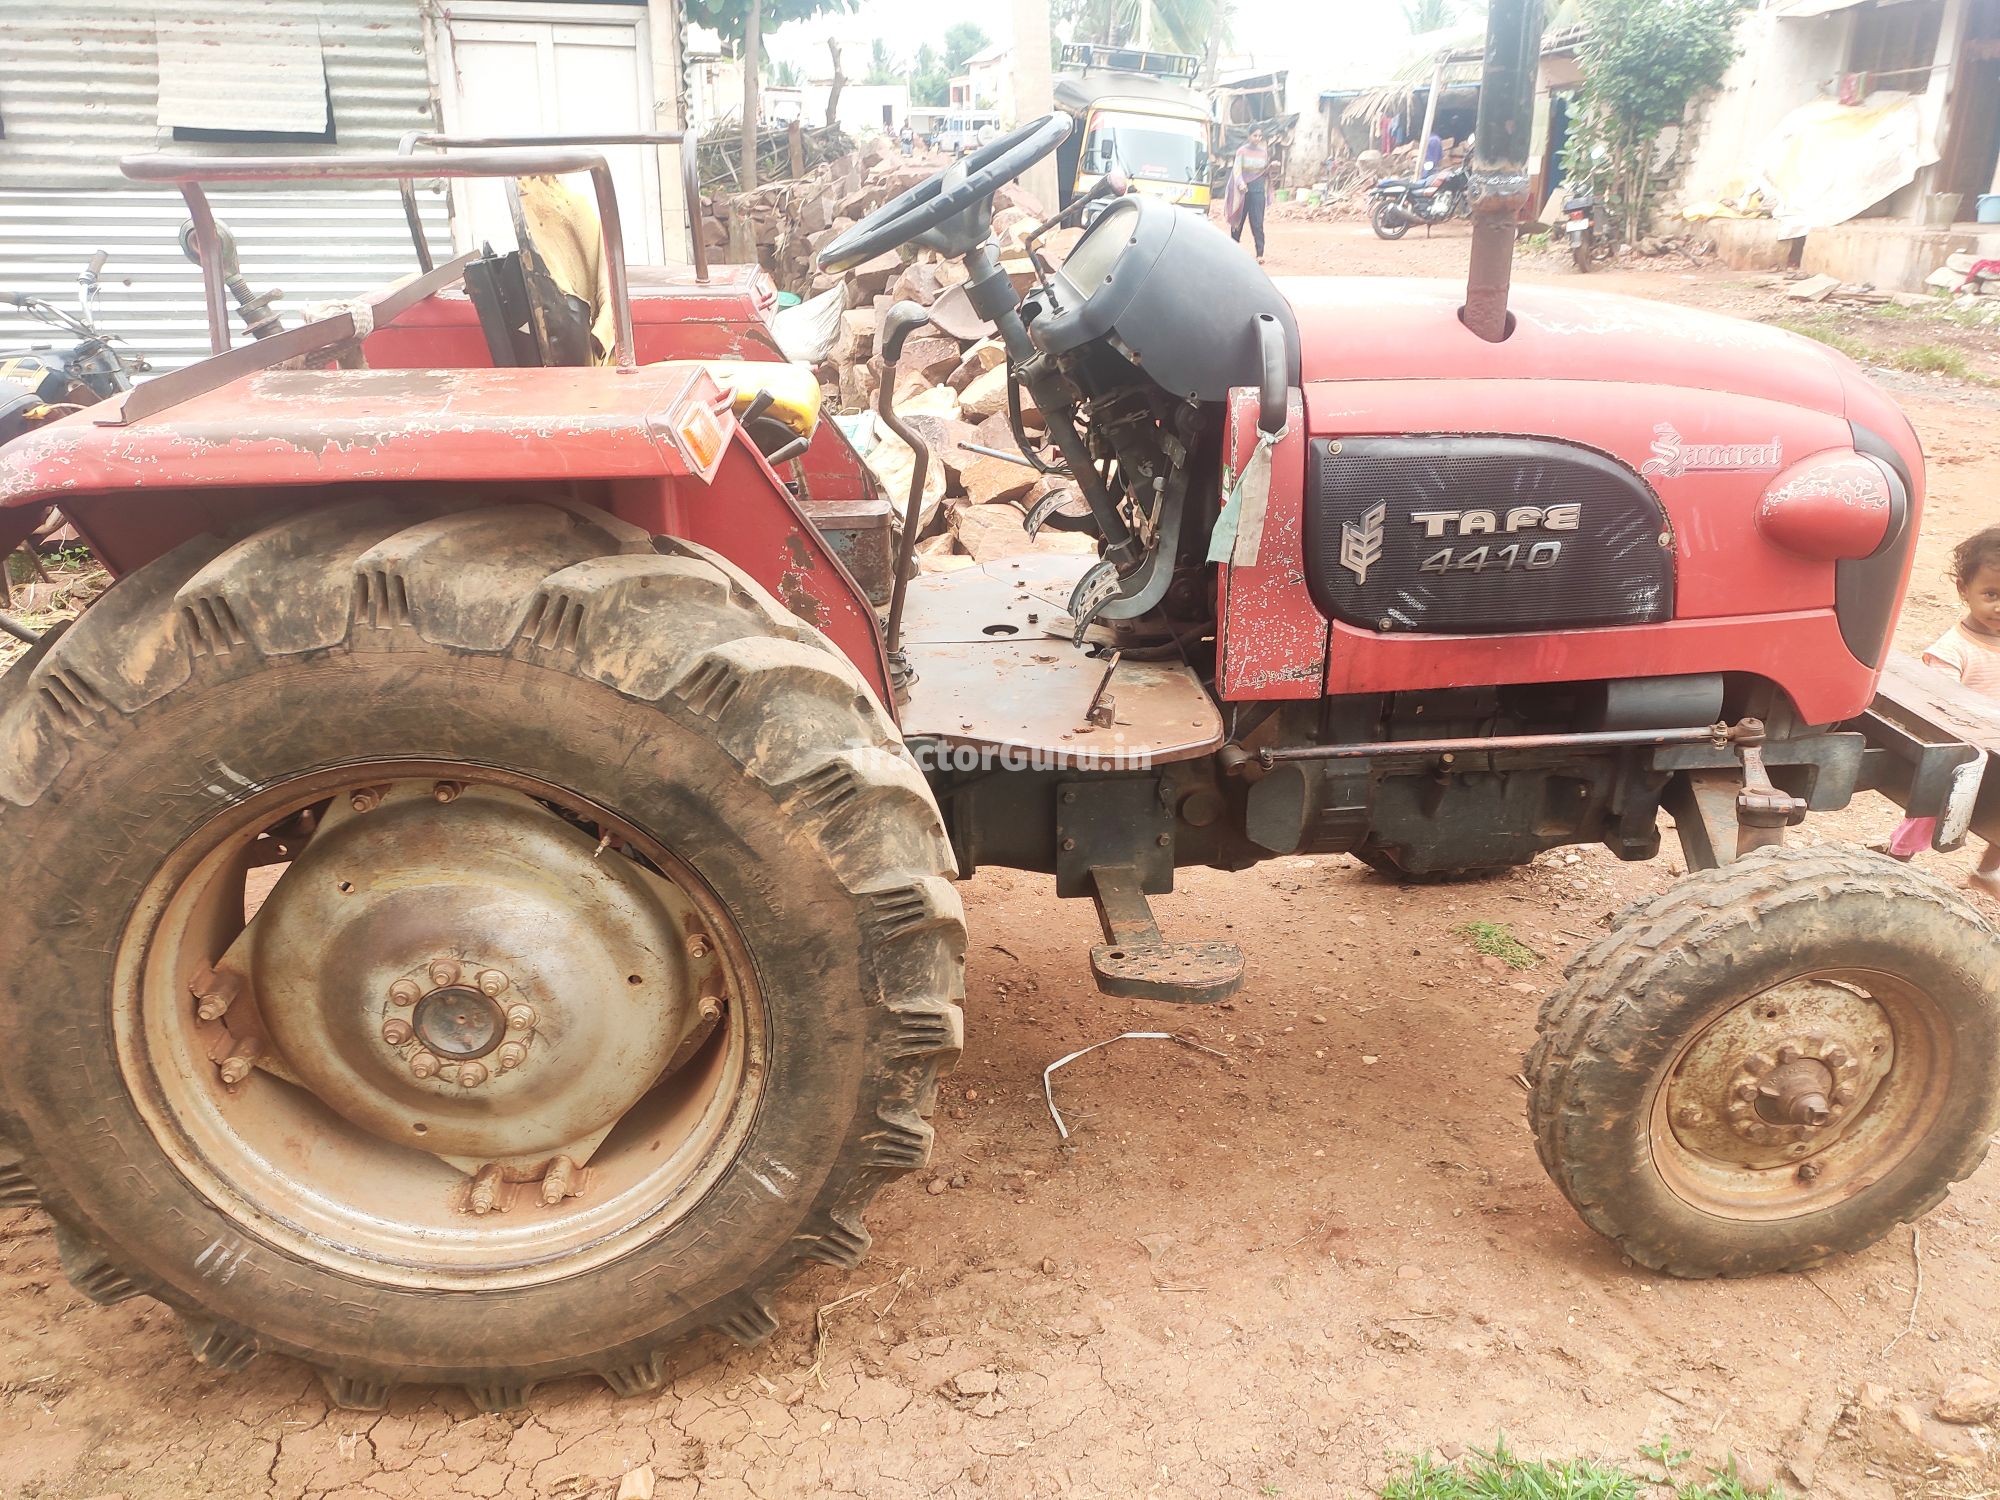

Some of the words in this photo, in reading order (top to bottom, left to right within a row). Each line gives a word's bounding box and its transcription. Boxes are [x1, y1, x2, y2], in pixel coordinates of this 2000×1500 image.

[1642, 422, 1782, 477] Samrat
[1410, 503, 1581, 538] TAFE
[1419, 541, 1562, 575] 4410
